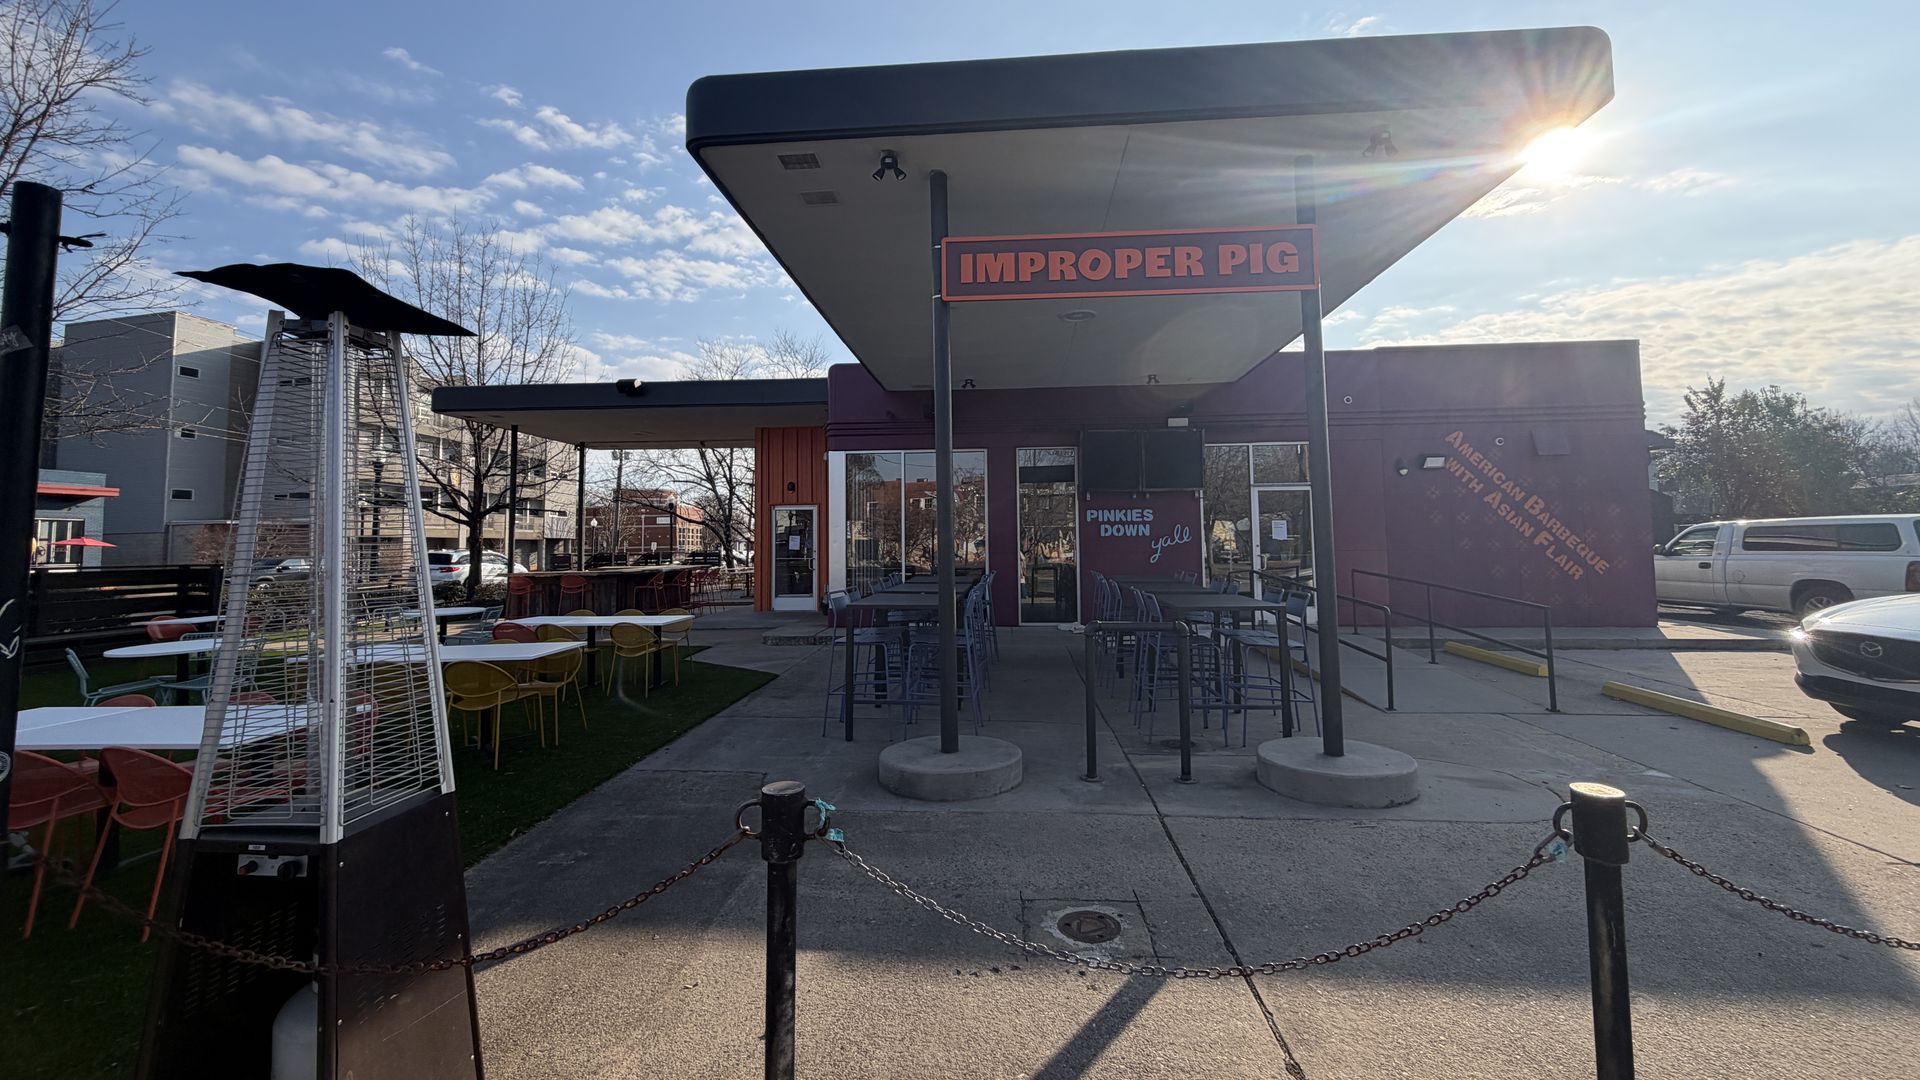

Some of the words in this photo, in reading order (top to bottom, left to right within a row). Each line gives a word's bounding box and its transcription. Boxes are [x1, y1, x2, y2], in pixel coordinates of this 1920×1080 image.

[960, 247, 1204, 284] IMPROPER
[1218, 241, 1300, 276] PIG
[1086, 509, 1154, 522] PINKIES
[1445, 431, 1526, 501] AMERICAN
[1524, 495, 1609, 575] BARBEQUE
[1446, 457, 1484, 493] WITH
[1483, 491, 1534, 537] ASIAN
[1534, 531, 1583, 580] FLAIR
[1100, 524, 1151, 537] DOWN
[1149, 523, 1192, 564] yall
